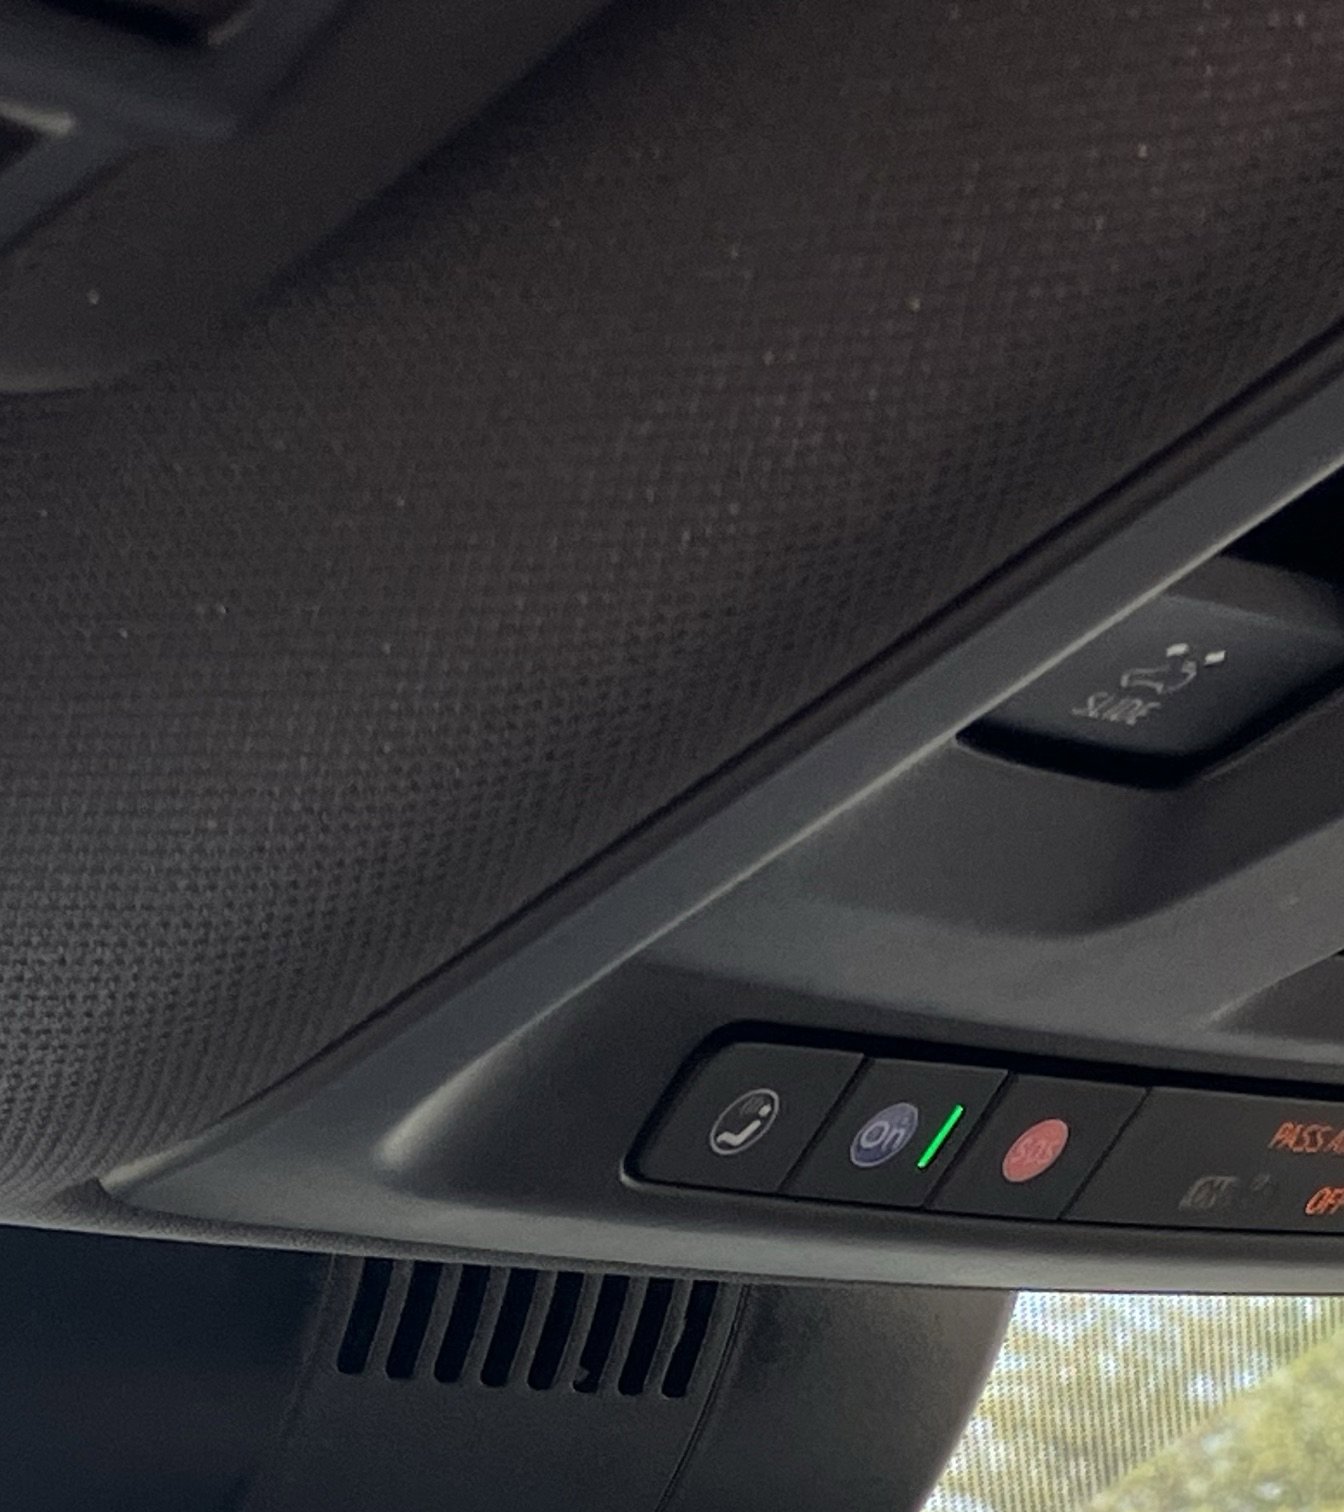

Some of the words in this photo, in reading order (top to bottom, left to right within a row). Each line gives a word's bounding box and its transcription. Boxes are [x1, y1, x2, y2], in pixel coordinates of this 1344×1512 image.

[860, 1121, 906, 1152] On
[1010, 1137, 1062, 1164] SOS
[1269, 1121, 1332, 1154] PASS
